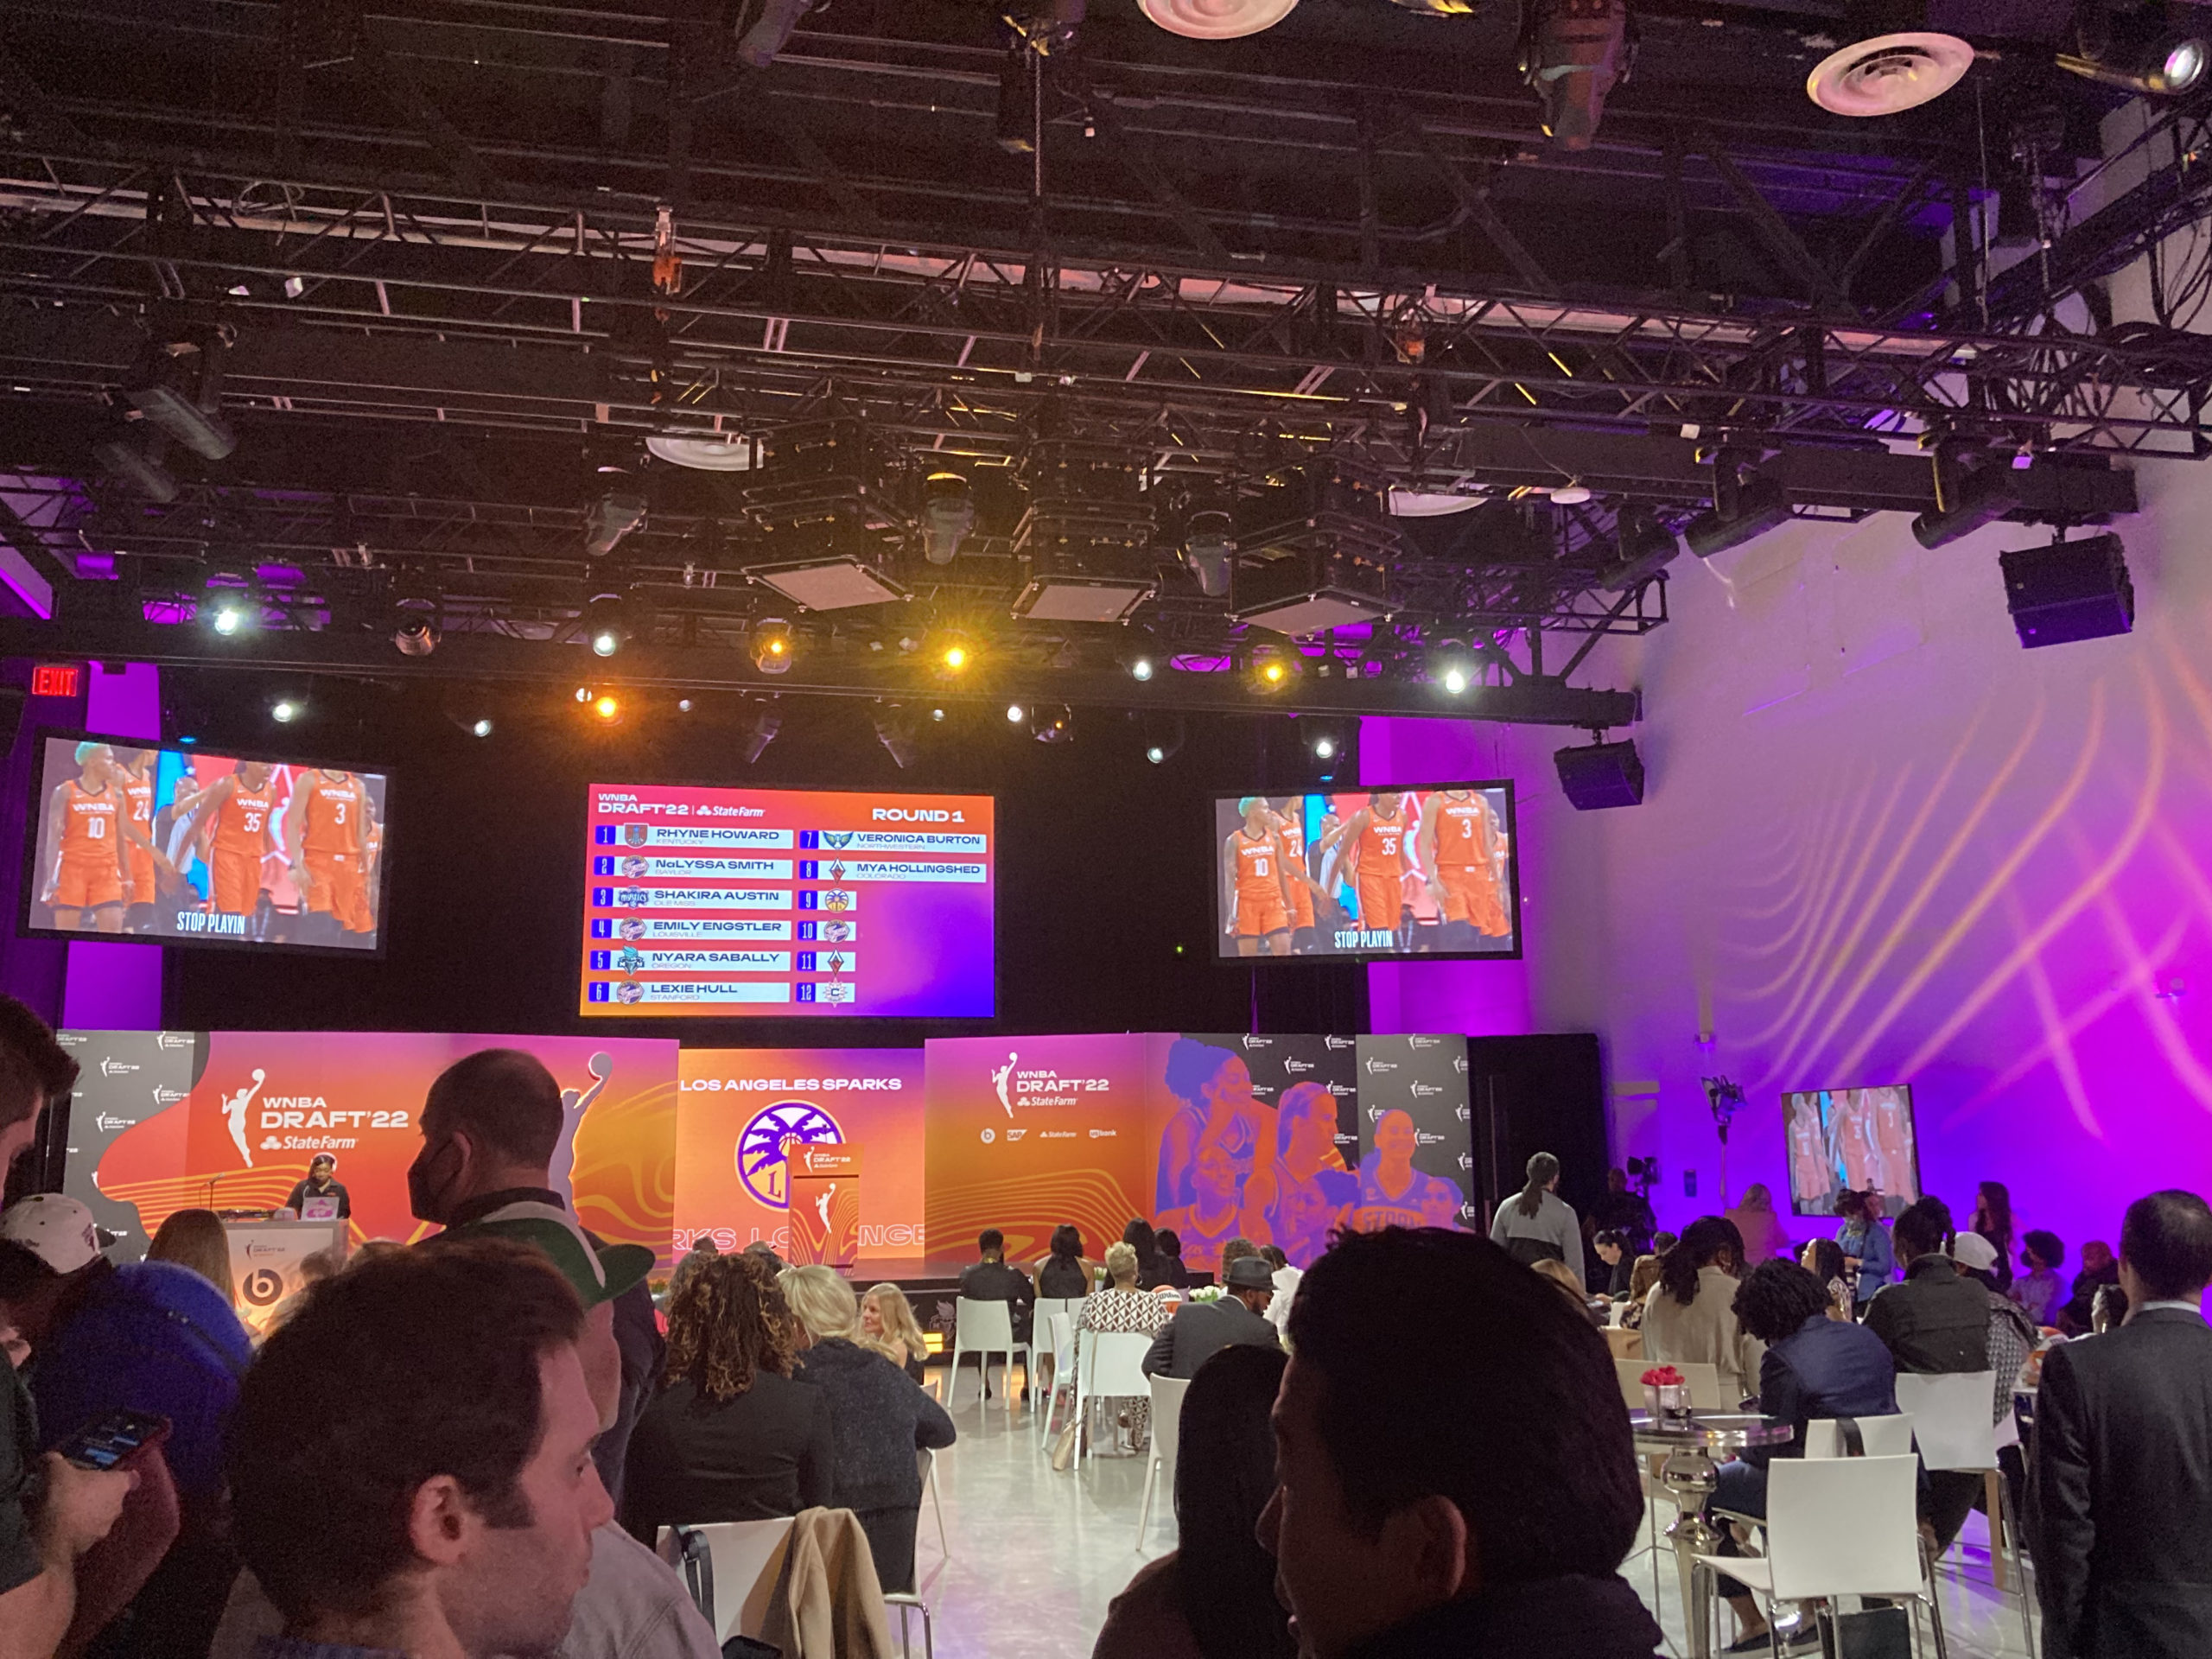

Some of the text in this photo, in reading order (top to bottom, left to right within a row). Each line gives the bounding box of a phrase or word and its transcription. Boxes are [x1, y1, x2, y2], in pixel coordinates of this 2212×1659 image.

[40, 669, 75, 693] EXIT
[237, 798, 270, 808] WNBA
[598, 793, 638, 802] WNBA
[334, 803, 346, 824] 3
[598, 804, 689, 815] DRAFT'22
[872, 808, 965, 823] ROUND 1
[1446, 806, 1479, 815] WNBA
[87, 817, 105, 838] 10
[243, 812, 262, 832] 35
[1373, 825, 1402, 834] WNBA
[1462, 818, 1472, 838] 3
[602, 828, 609, 843] 1
[657, 829, 779, 840] RHYNE HOWARD
[806, 831, 812, 848] 7
[857, 834, 980, 844] VERONICA BURTON
[1382, 837, 1396, 855] 35
[656, 860, 773, 870] NaLYSSA SMITH
[806, 862, 811, 877] 8
[889, 864, 981, 874] HOLLINGSHED
[1254, 858, 1268, 877] 10
[600, 890, 606, 906] 3
[654, 890, 779, 900] SHAKIRA AUSTIN
[805, 893, 811, 907] 9
[177, 911, 245, 935] STOP PLAYIN
[598, 921, 605, 937] 4
[653, 921, 782, 931] EMILY ENGSTLER
[802, 923, 813, 939] 10
[1334, 930, 1394, 949] STOP PLAYIN
[597, 952, 603, 968] 5
[652, 952, 779, 962] NYARA SABALLY
[801, 954, 812, 969] 11
[596, 983, 602, 1000] 6
[652, 984, 695, 993] LEXIE
[800, 984, 812, 1001] 12
[1016, 1070, 1058, 1078] WNBA
[680, 1078, 902, 1091] LOS ANGELES SPARKS
[1016, 1078, 1109, 1092] DRAFT'22
[262, 1096, 327, 1109] WNBA
[260, 1110, 409, 1129] DRAFT'22
